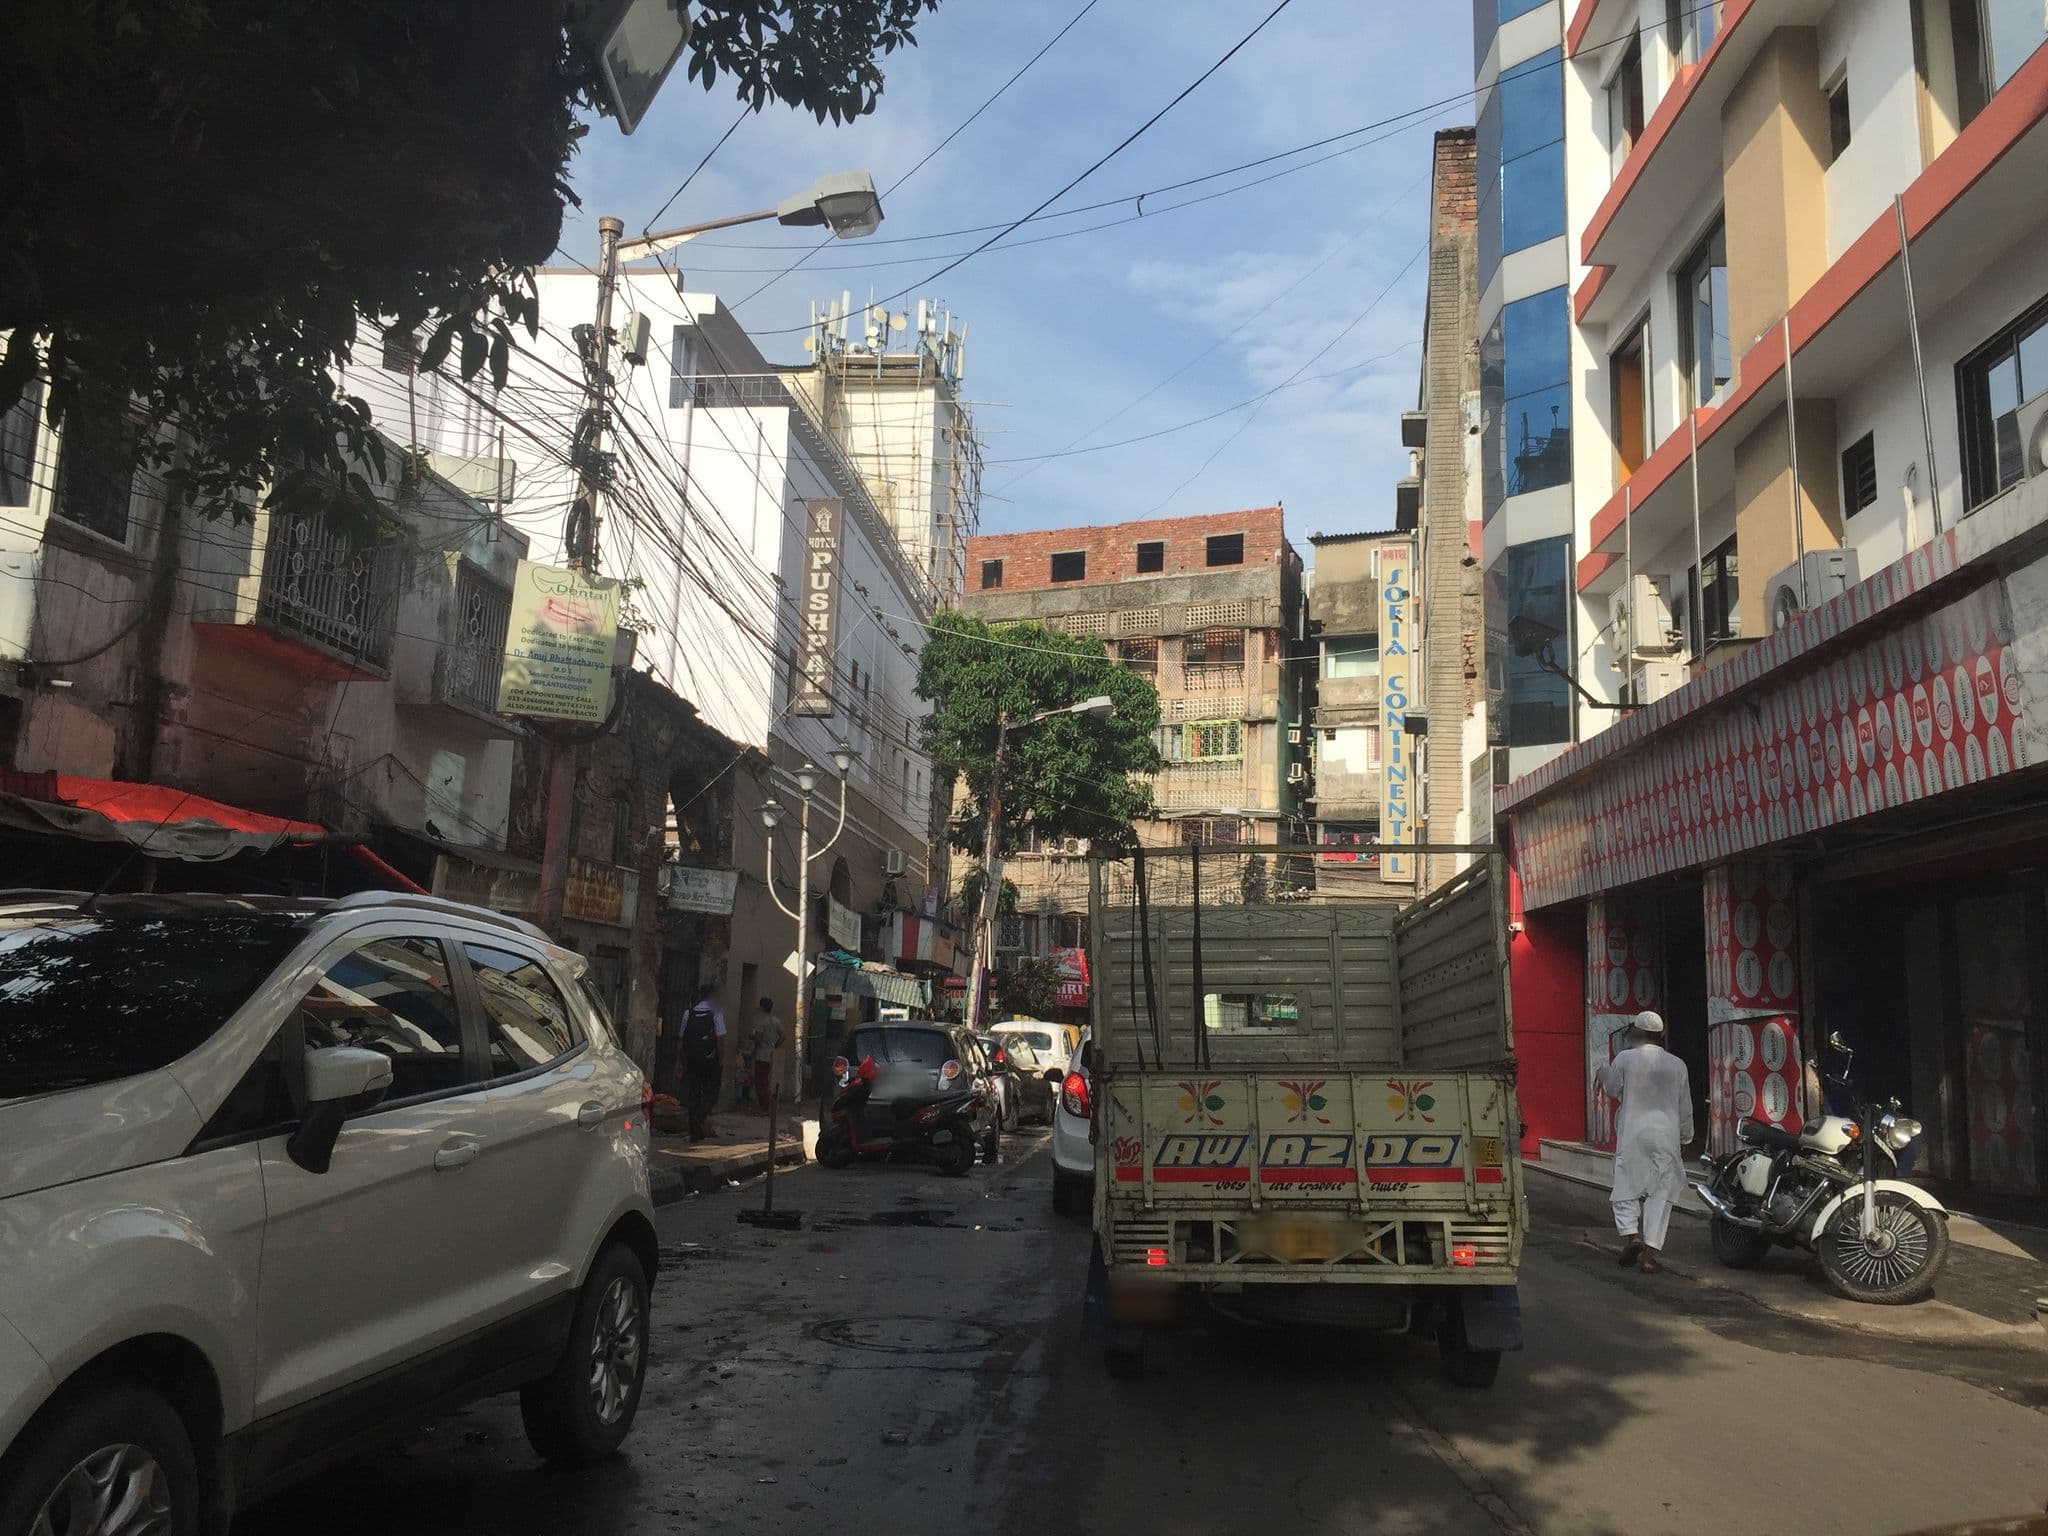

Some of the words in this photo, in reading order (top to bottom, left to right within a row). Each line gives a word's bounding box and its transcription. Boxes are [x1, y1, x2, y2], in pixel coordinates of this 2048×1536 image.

[808, 537, 837, 549] HOTEL
[557, 584, 607, 600] Dental
[1384, 569, 1407, 656] SOFIA
[803, 552, 832, 693] PUSHPAK
[525, 690, 574, 701] APPOINTMENT
[571, 710, 597, 718] PRACTO
